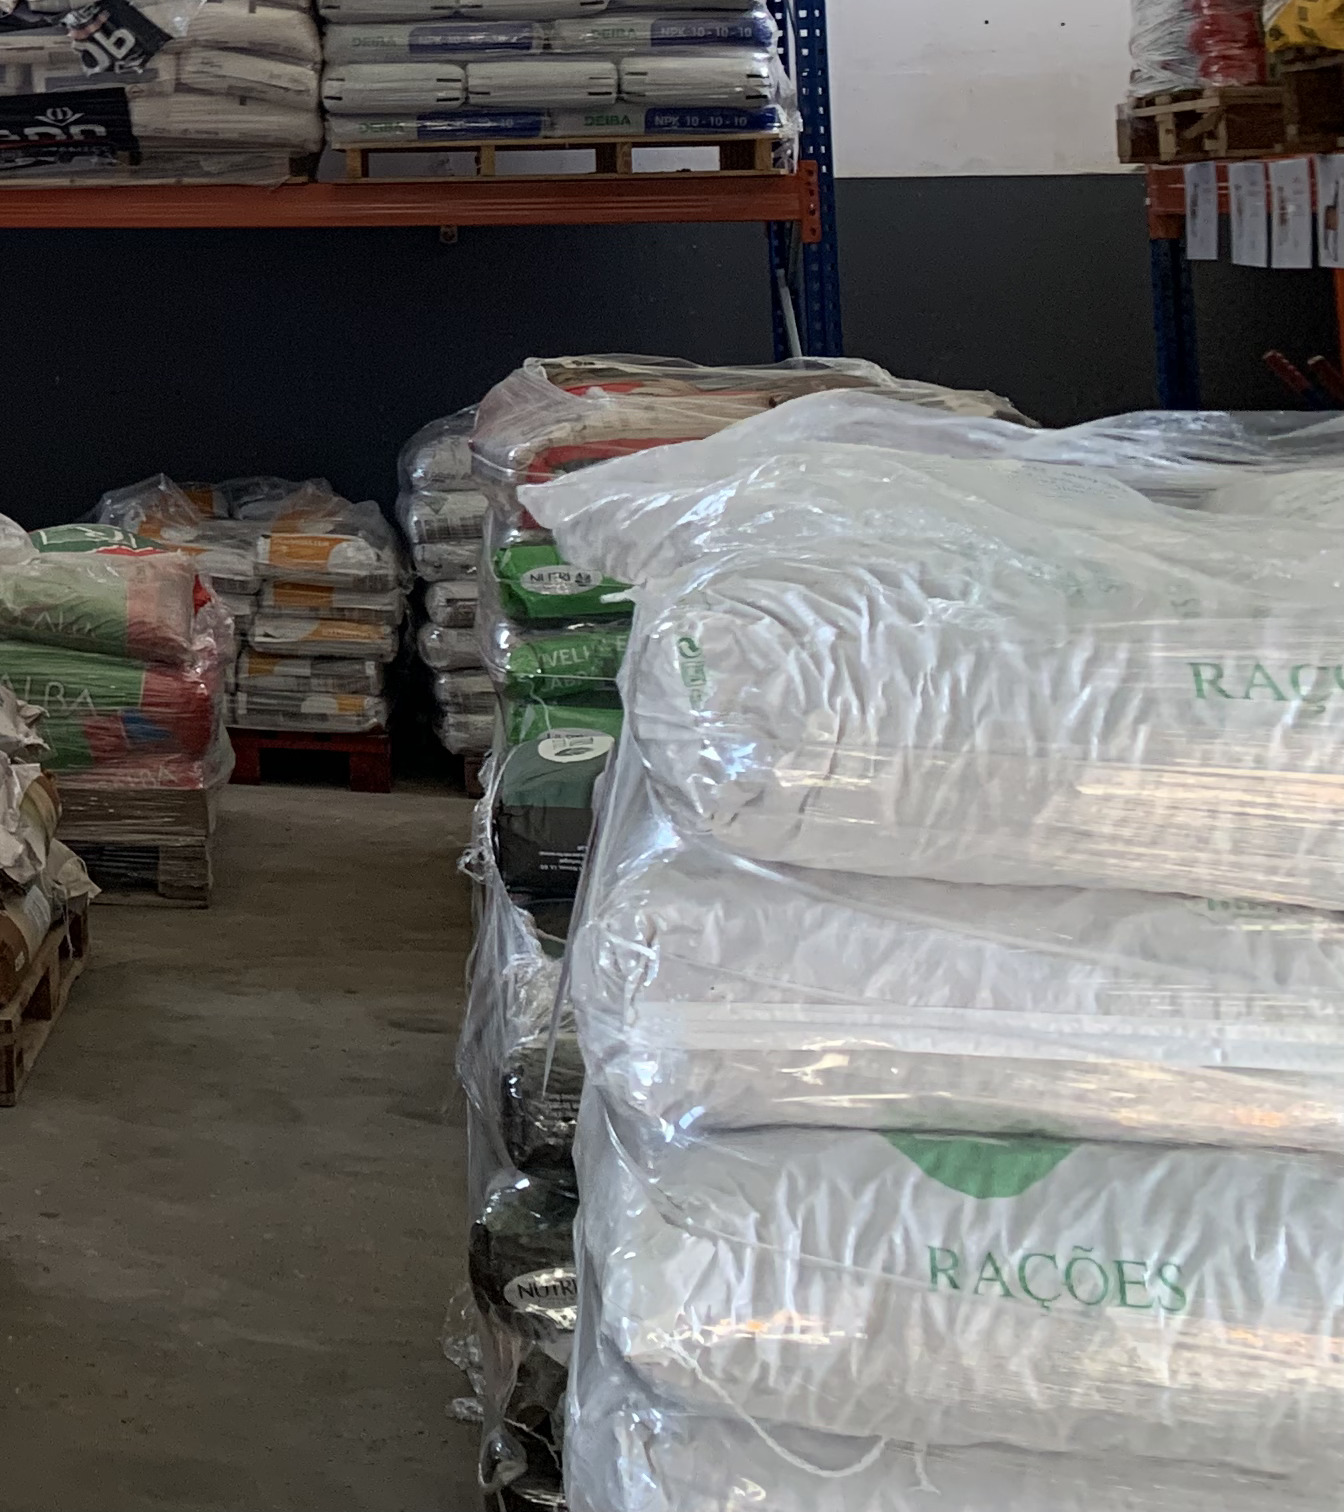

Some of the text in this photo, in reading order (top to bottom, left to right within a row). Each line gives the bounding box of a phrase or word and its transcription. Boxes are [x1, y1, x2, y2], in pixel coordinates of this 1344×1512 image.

[660, 27, 753, 39] NPK 10 10 10
[584, 114, 631, 128] DEIBA
[653, 115, 748, 128] NPK 10 10 10
[1186, 661, 1344, 715] RAÇ
[927, 1245, 1188, 1315] RAÇÕES
